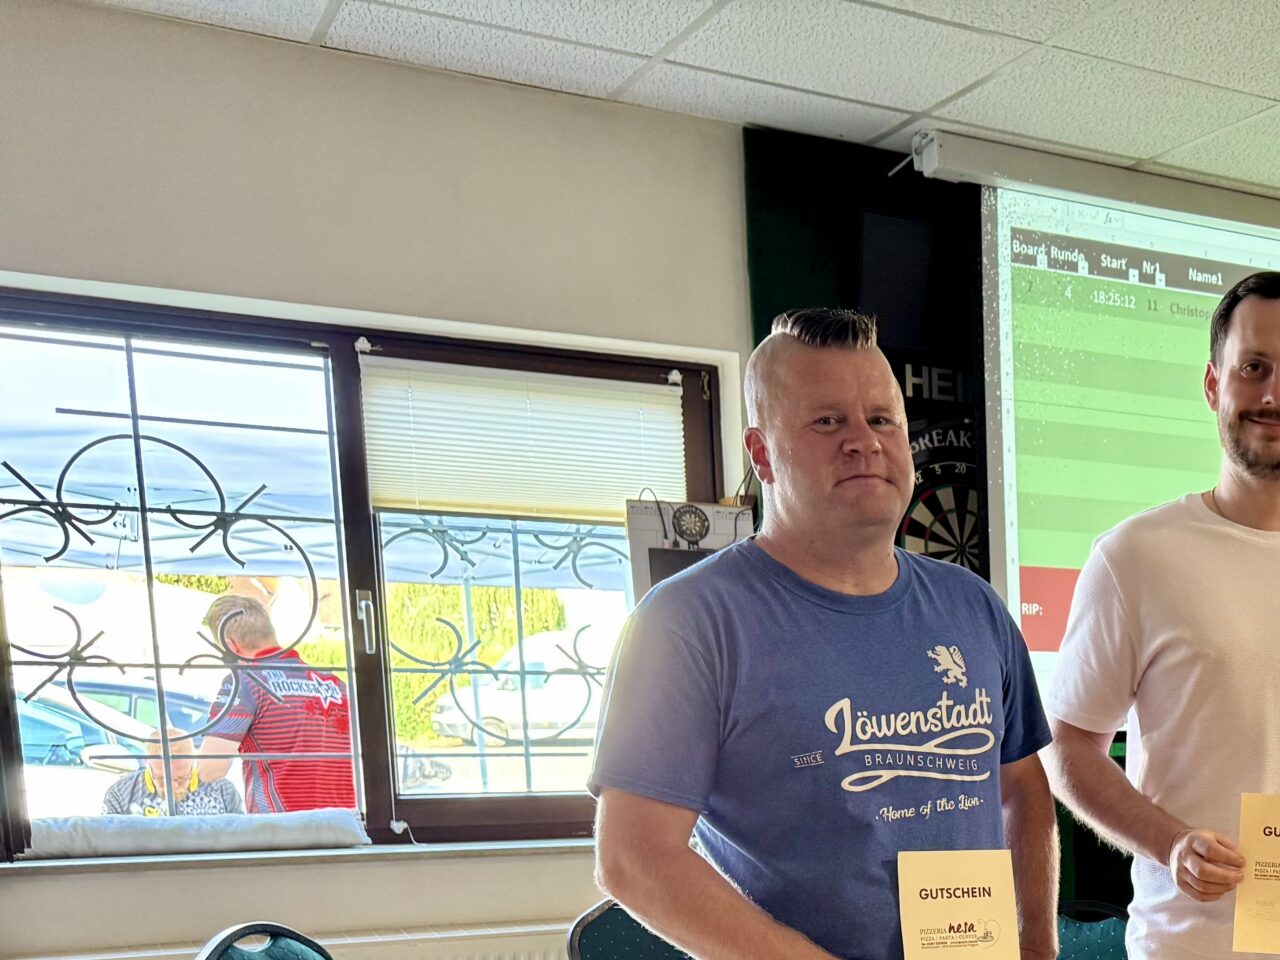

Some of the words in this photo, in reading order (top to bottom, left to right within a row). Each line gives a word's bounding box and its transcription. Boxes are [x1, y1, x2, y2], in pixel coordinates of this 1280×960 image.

[1012, 239, 1046, 257] Board
[1050, 245, 1085, 263] Runde
[1100, 253, 1126, 270] Start
[1142, 260, 1160, 275] Nr1
[1188, 267, 1223, 285] Name1
[1092, 289, 1136, 309] 18:25:12
[1146, 299, 1158, 312] 11
[1169, 302, 1213, 320] Christop
[1021, 602, 1043, 616] RIP:
[824, 688, 993, 756] Löwenstadt
[794, 753, 822, 765] SINCE
[865, 753, 978, 771] BRAUNSCHWEIG
[936, 797, 956, 812] the
[919, 886, 992, 900] GUTSCHEIN
